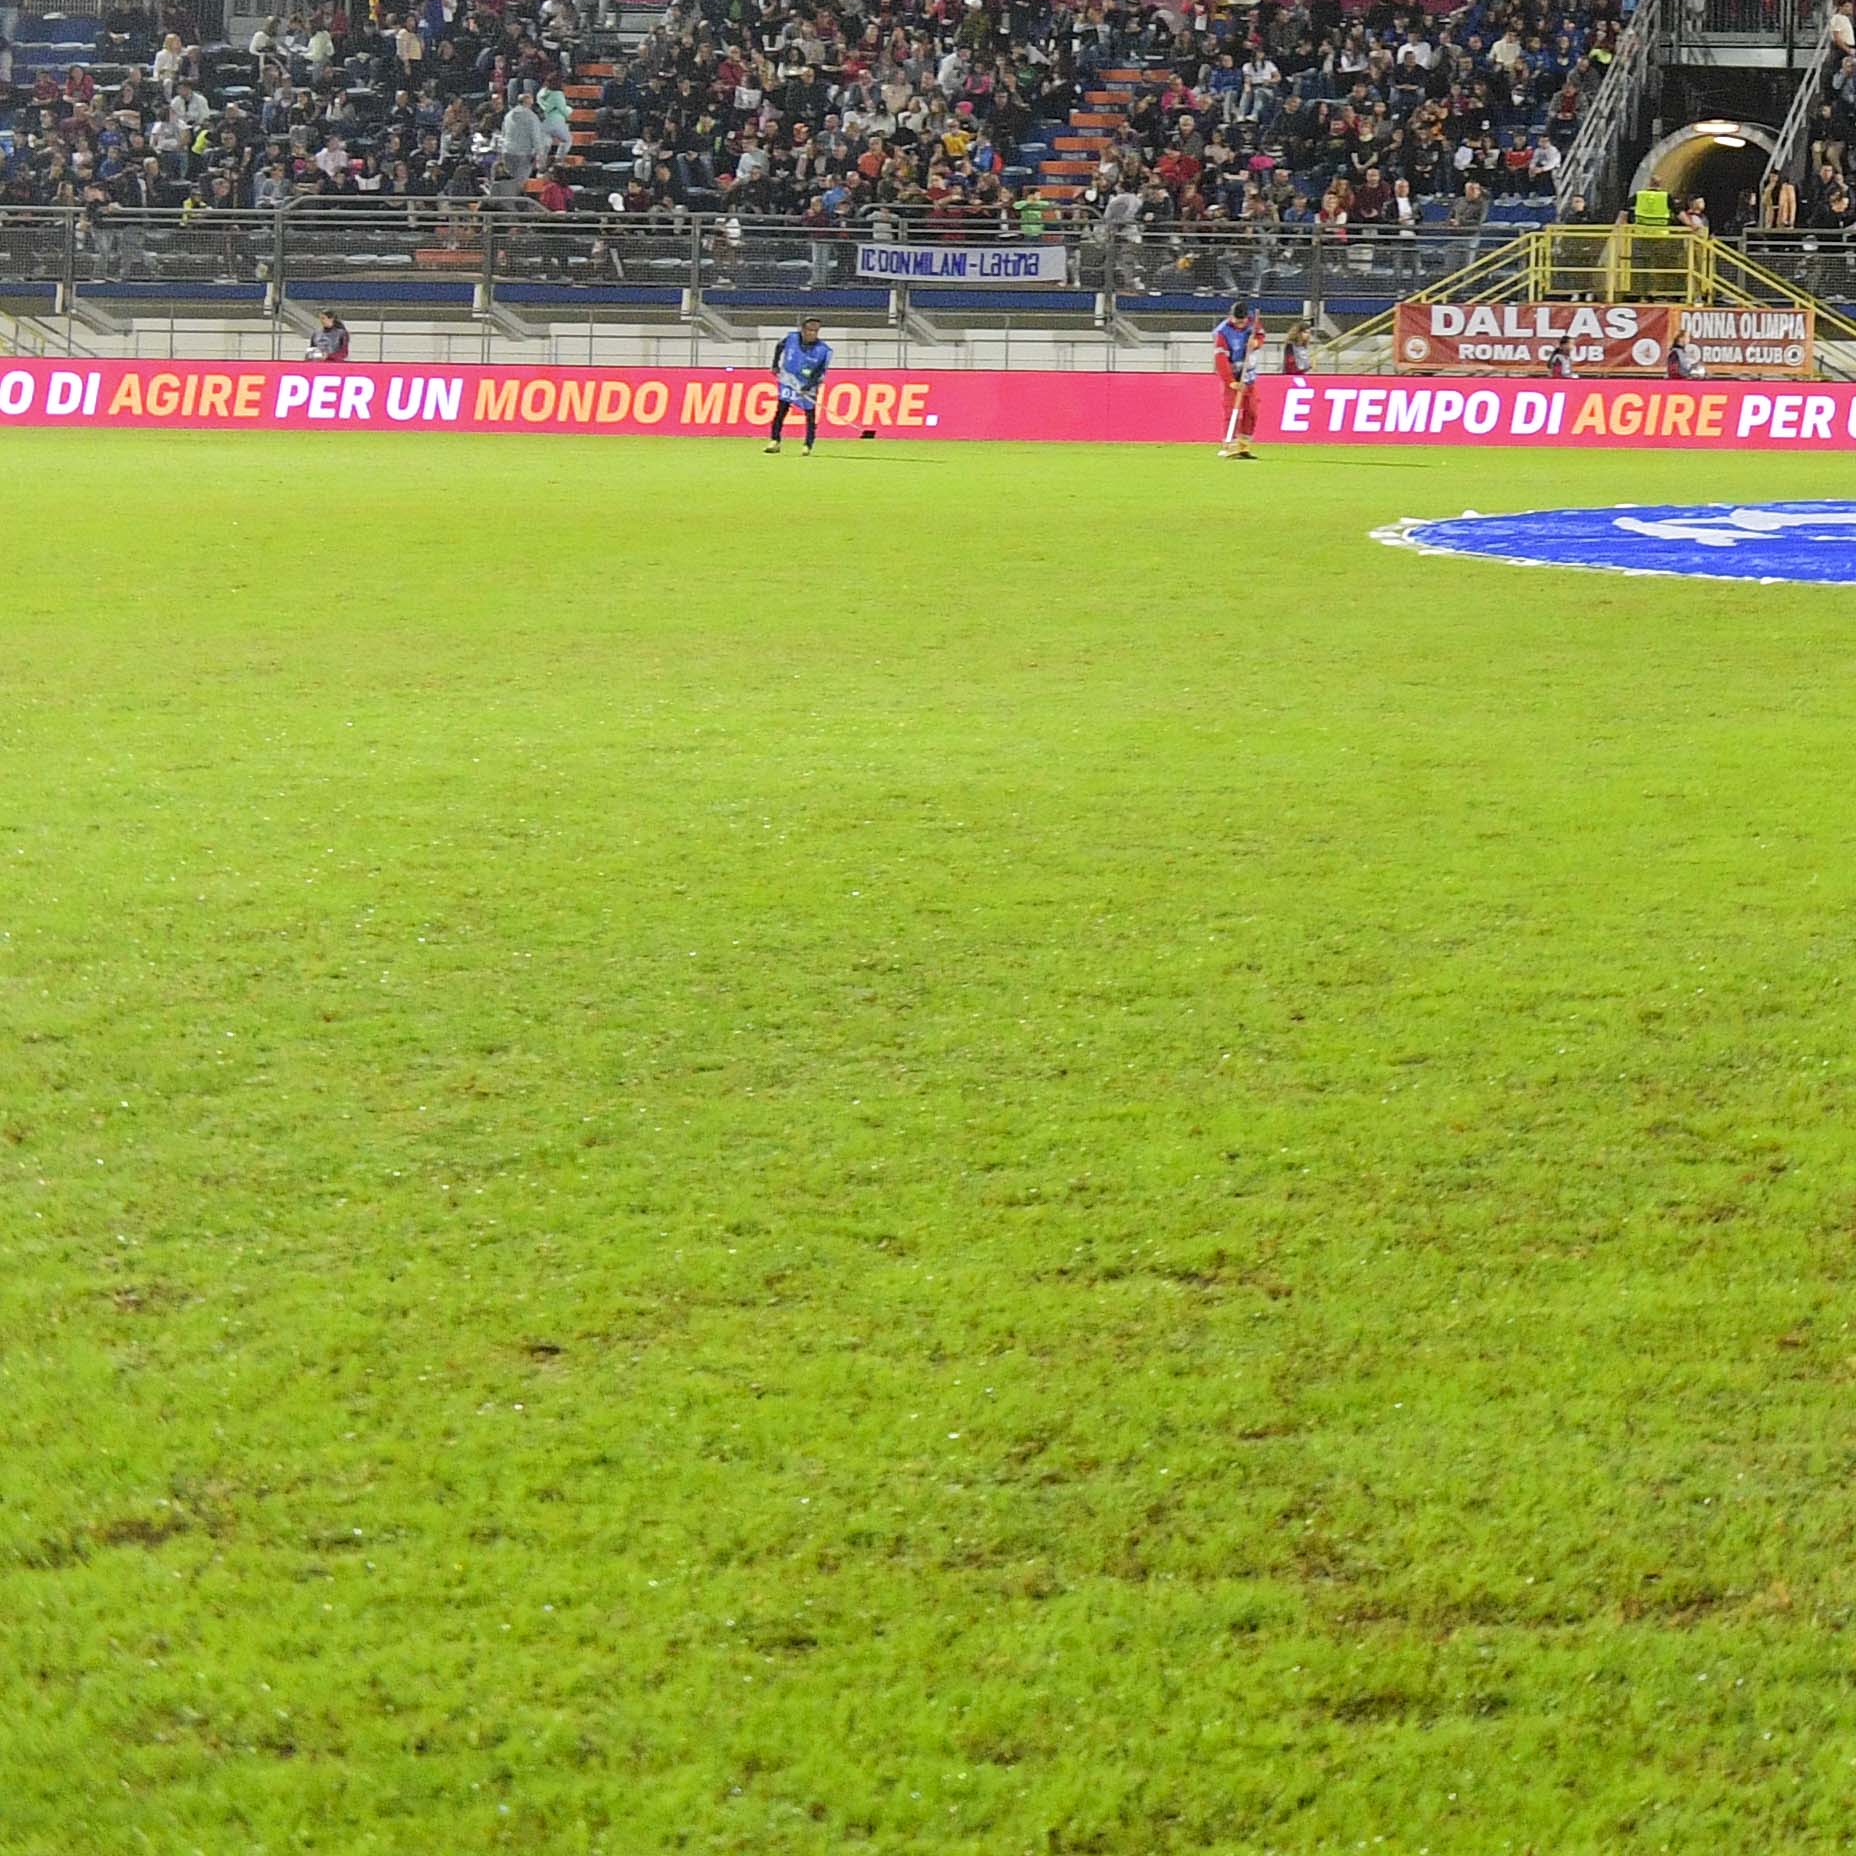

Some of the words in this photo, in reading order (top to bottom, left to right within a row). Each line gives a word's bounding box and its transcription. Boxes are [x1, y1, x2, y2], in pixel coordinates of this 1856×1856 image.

[1431, 305, 1639, 338] DALLAS
[1680, 311, 1738, 339] DONNA
[1739, 311, 1805, 340] OLIMPIA
[1458, 343, 1531, 361] ROMA
[1538, 343, 1604, 361] CUB
[1702, 345, 1744, 363] ROMA
[1745, 346, 1784, 364] CLUB
[46, 372, 101, 416] DI
[108, 373, 266, 417] AGIRE
[275, 375, 375, 420] PER
[386, 377, 464, 421] UN
[474, 380, 669, 424] MONDO
[1280, 377, 1315, 432] È
[1325, 388, 1500, 434] TEMPO
[1510, 391, 1566, 435] DI
[1572, 393, 1728, 437] AGIRE
[1736, 395, 1836, 439] PER
